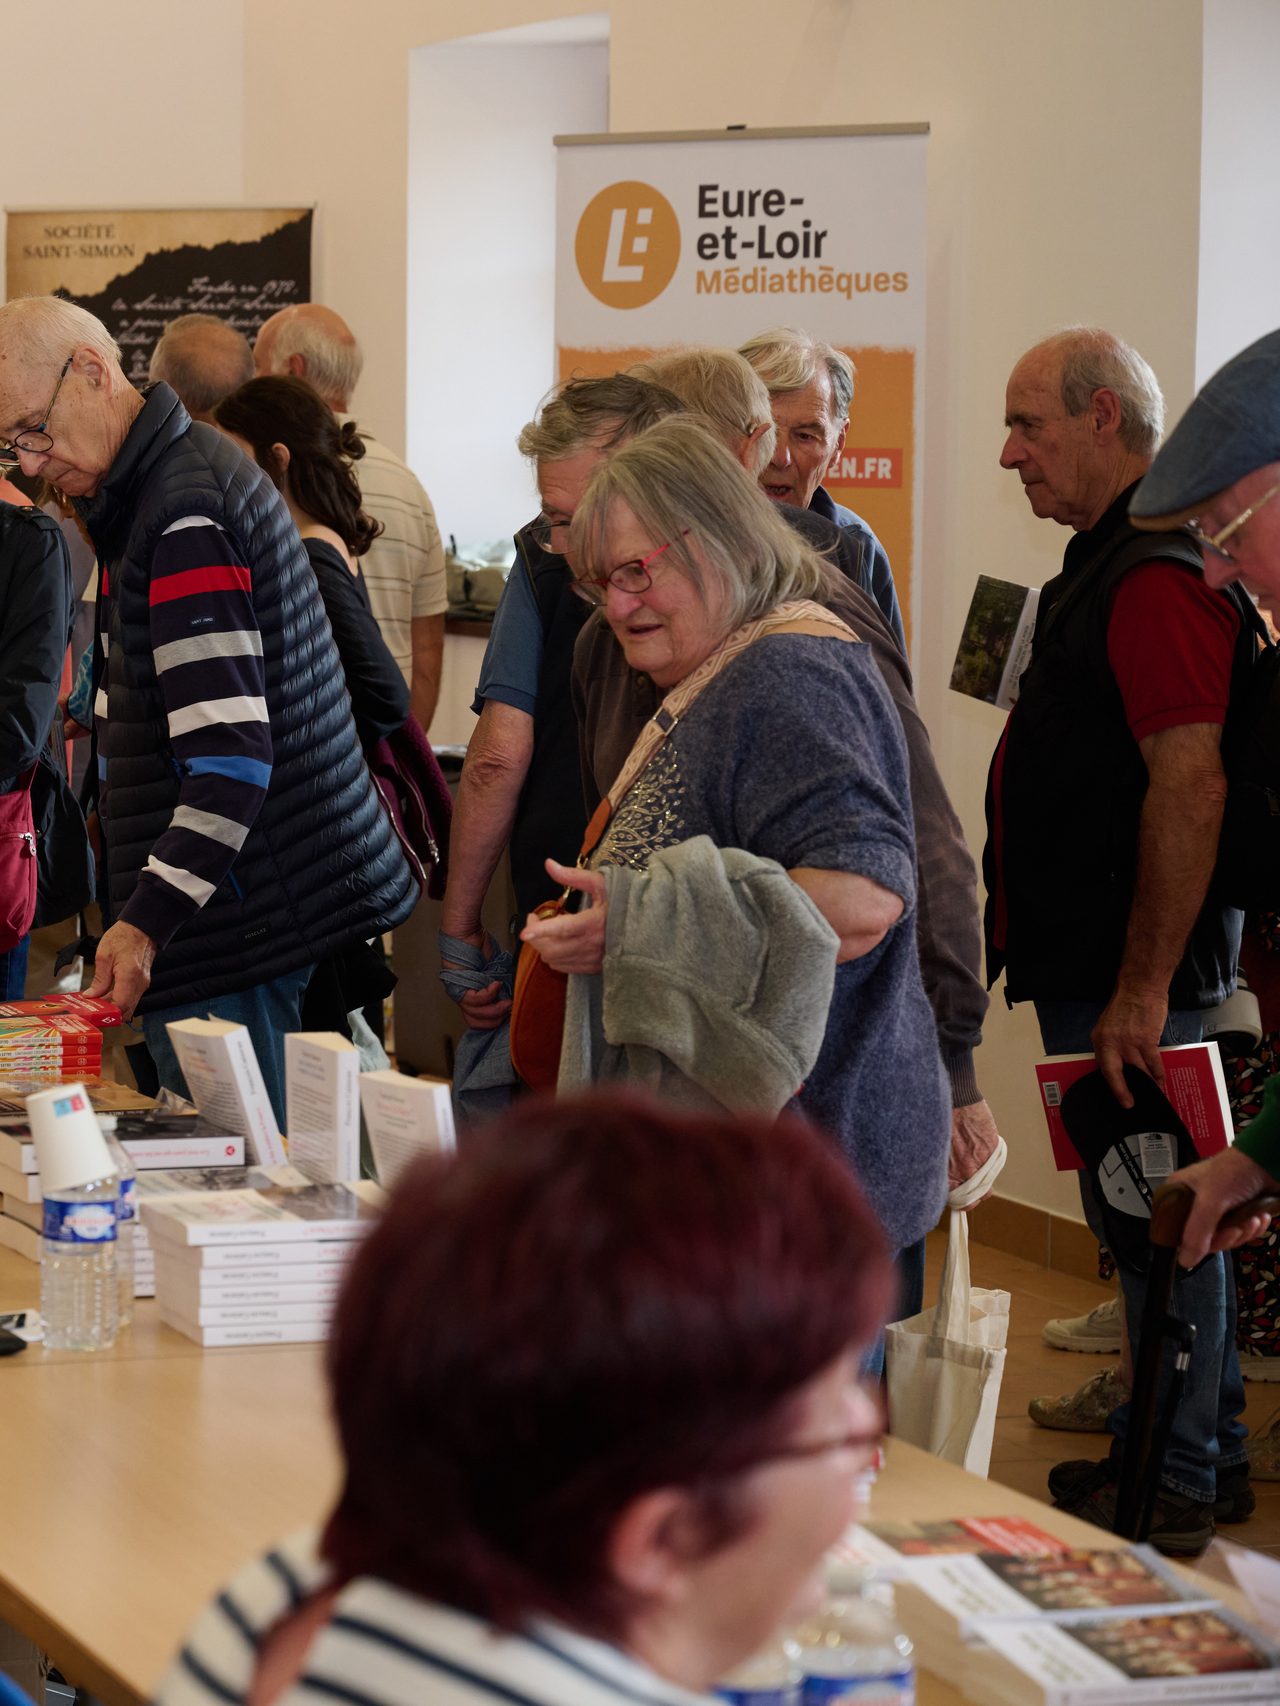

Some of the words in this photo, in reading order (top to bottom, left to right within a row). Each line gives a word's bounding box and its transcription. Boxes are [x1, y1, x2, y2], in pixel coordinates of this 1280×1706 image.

[697, 184, 805, 218] Eure-
[43, 222, 116, 239] SOCIÉTÉ
[696, 219, 828, 260] et-Loir
[827, 457, 892, 480] EN.FR
